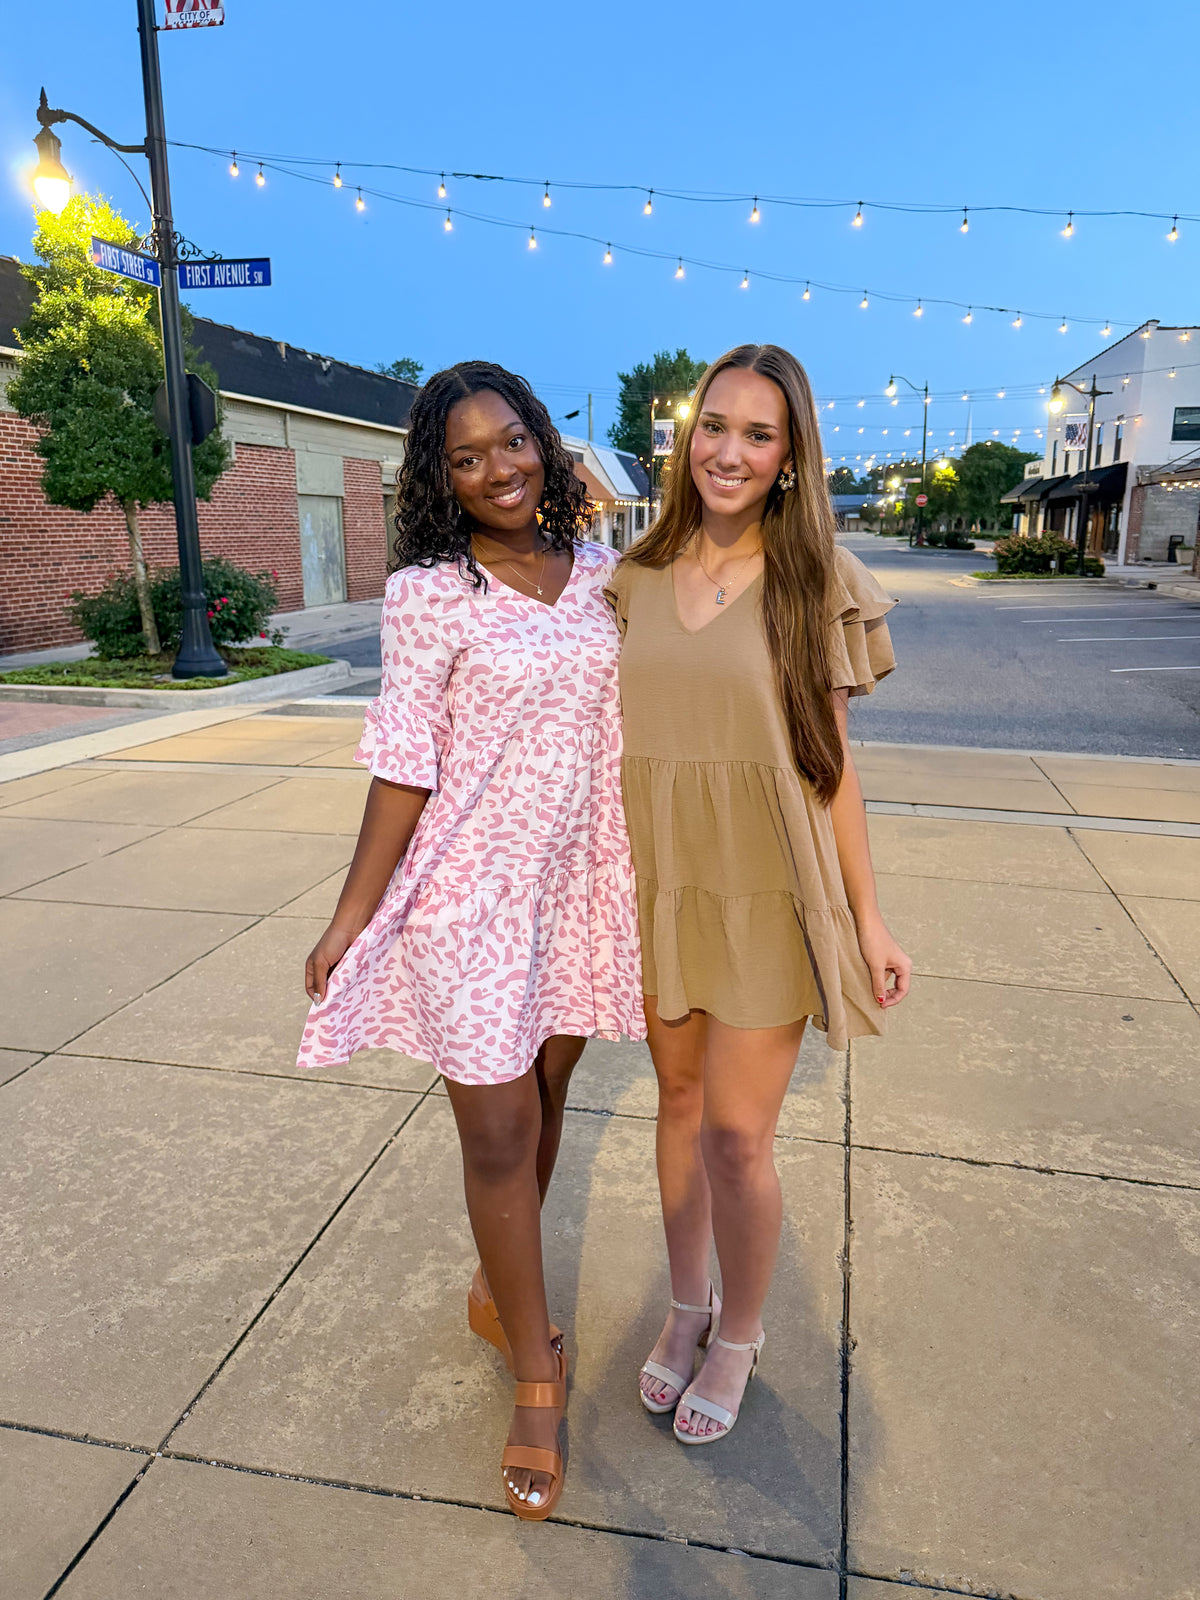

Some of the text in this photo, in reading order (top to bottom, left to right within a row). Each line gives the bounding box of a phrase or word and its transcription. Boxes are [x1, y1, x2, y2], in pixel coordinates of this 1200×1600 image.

[179, 11, 210, 21] CITY OF
[100, 244, 120, 271] FIRST
[121, 251, 145, 279] STREET
[186, 264, 263, 286] FIRST AVENUE SW
